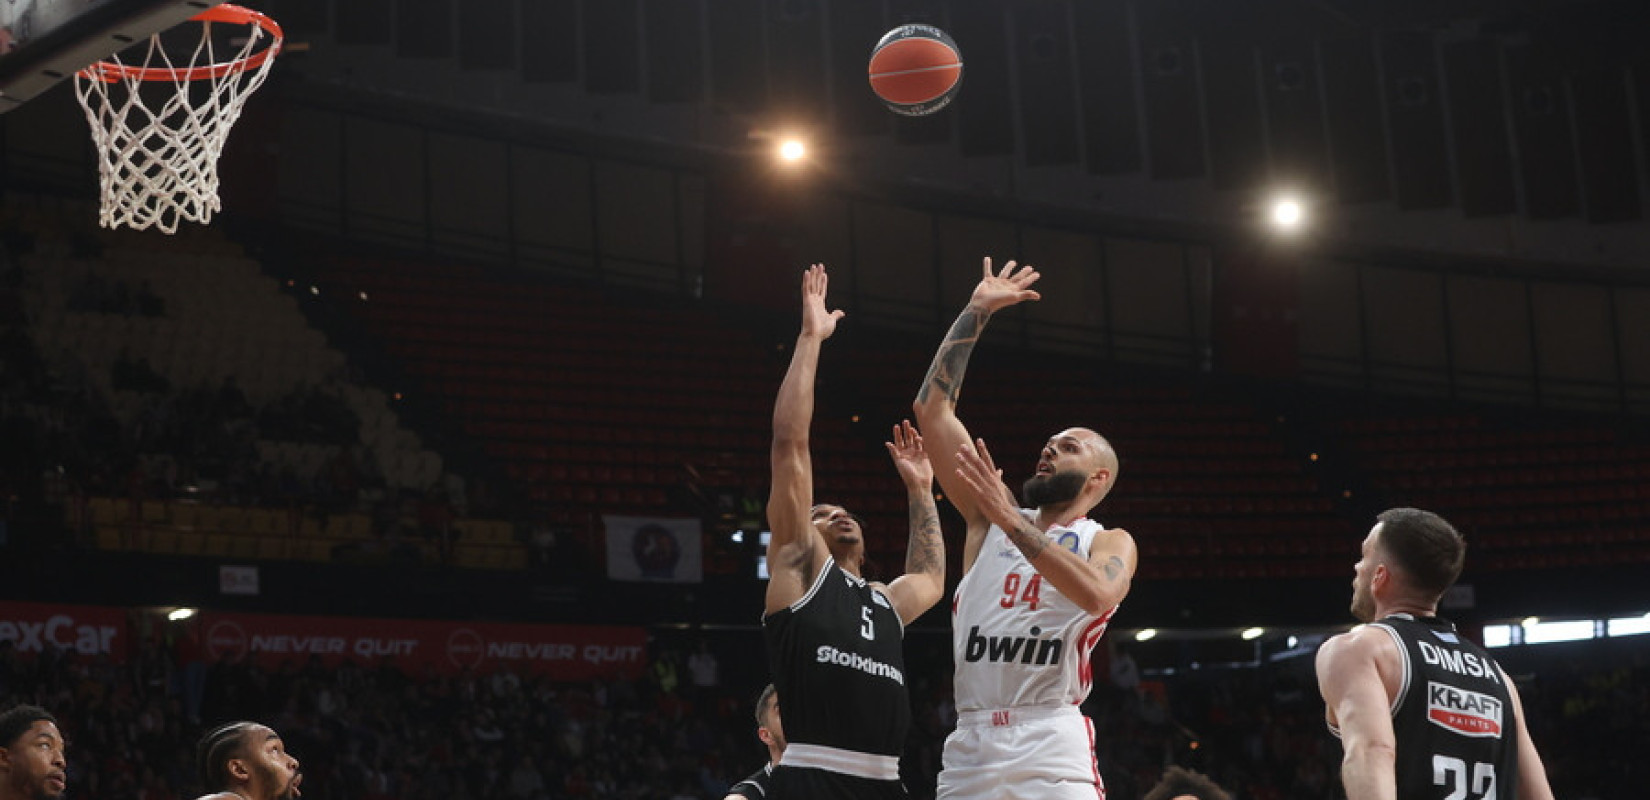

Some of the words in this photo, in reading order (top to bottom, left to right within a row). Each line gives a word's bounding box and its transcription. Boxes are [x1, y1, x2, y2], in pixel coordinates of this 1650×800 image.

[1000, 573, 1043, 611] 94
[861, 605, 875, 640] 5
[251, 635, 346, 653] NEVER
[354, 637, 419, 658] QUIT
[488, 641, 576, 660] NEVER
[583, 645, 642, 664] QUIT
[965, 625, 1063, 665] bwin
[1430, 685, 1500, 720] KRAFT
[1449, 715, 1490, 729] PAINTS
